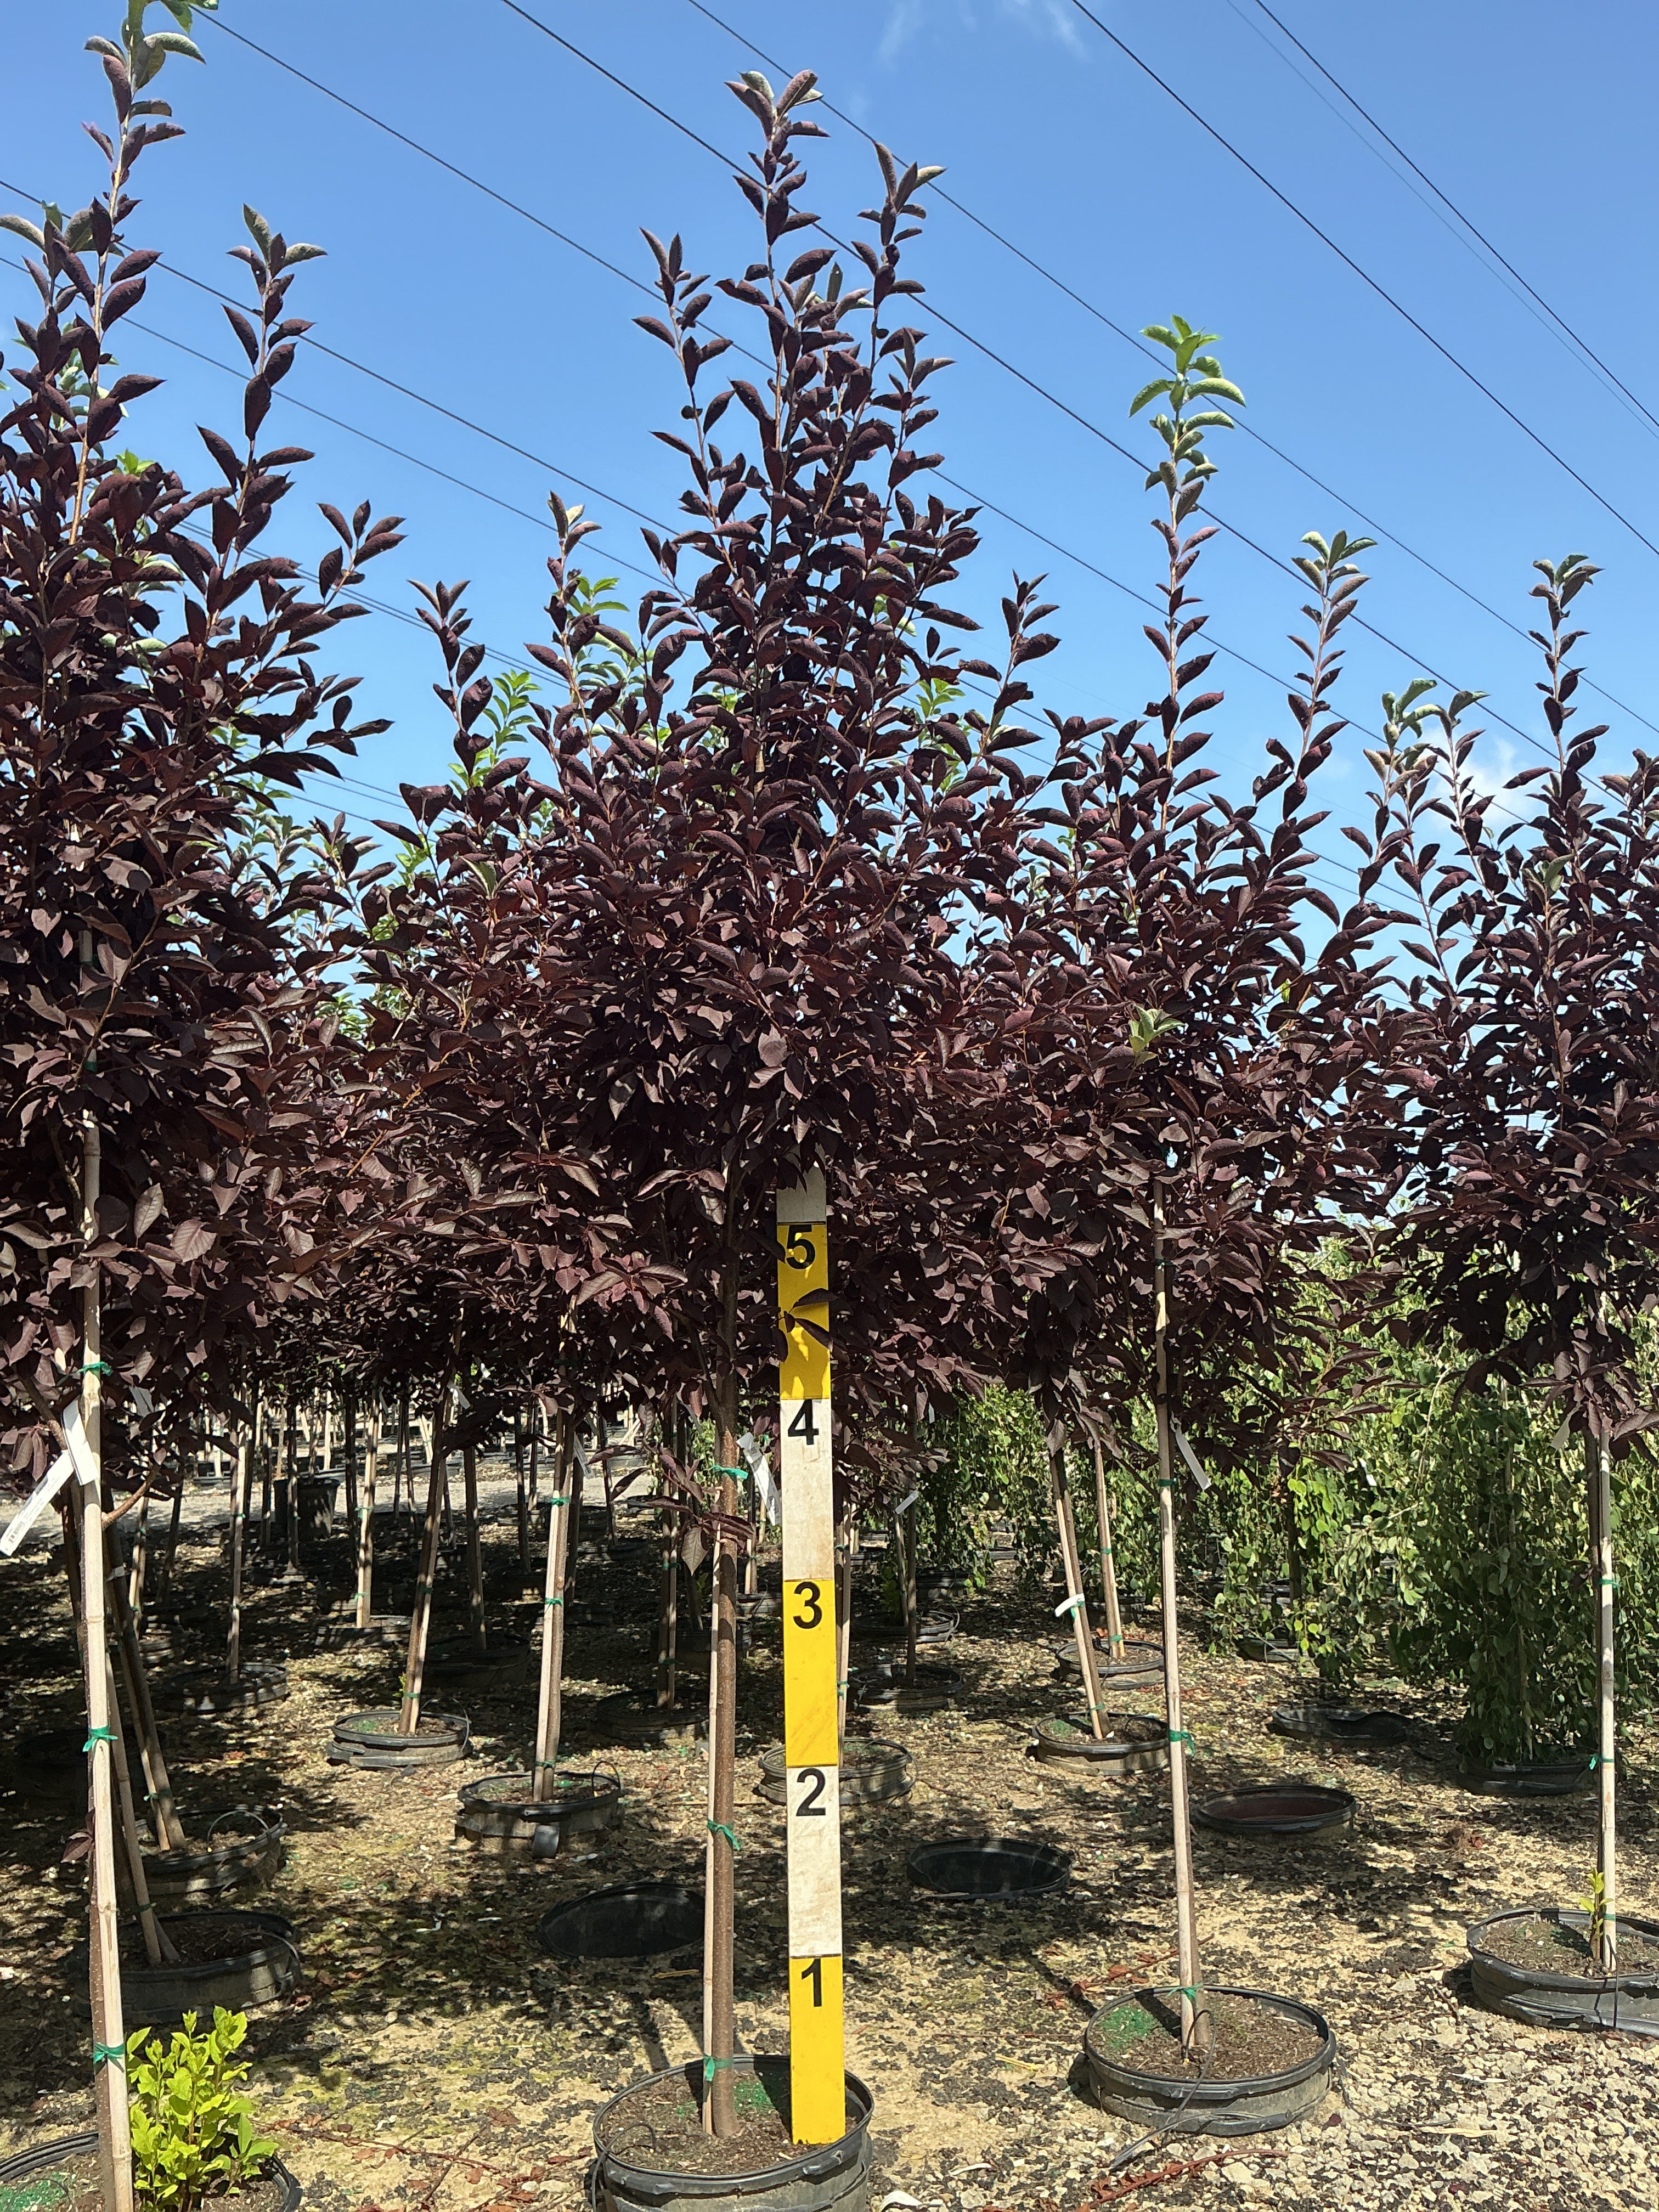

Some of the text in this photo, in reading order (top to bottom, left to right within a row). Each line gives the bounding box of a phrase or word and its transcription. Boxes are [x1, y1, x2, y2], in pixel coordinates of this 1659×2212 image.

[787, 1224, 816, 1269] 5
[788, 1399, 819, 1445] 4
[793, 1581, 822, 1629] 3
[796, 1768, 826, 1816] 2
[801, 1957, 822, 2007] 1
